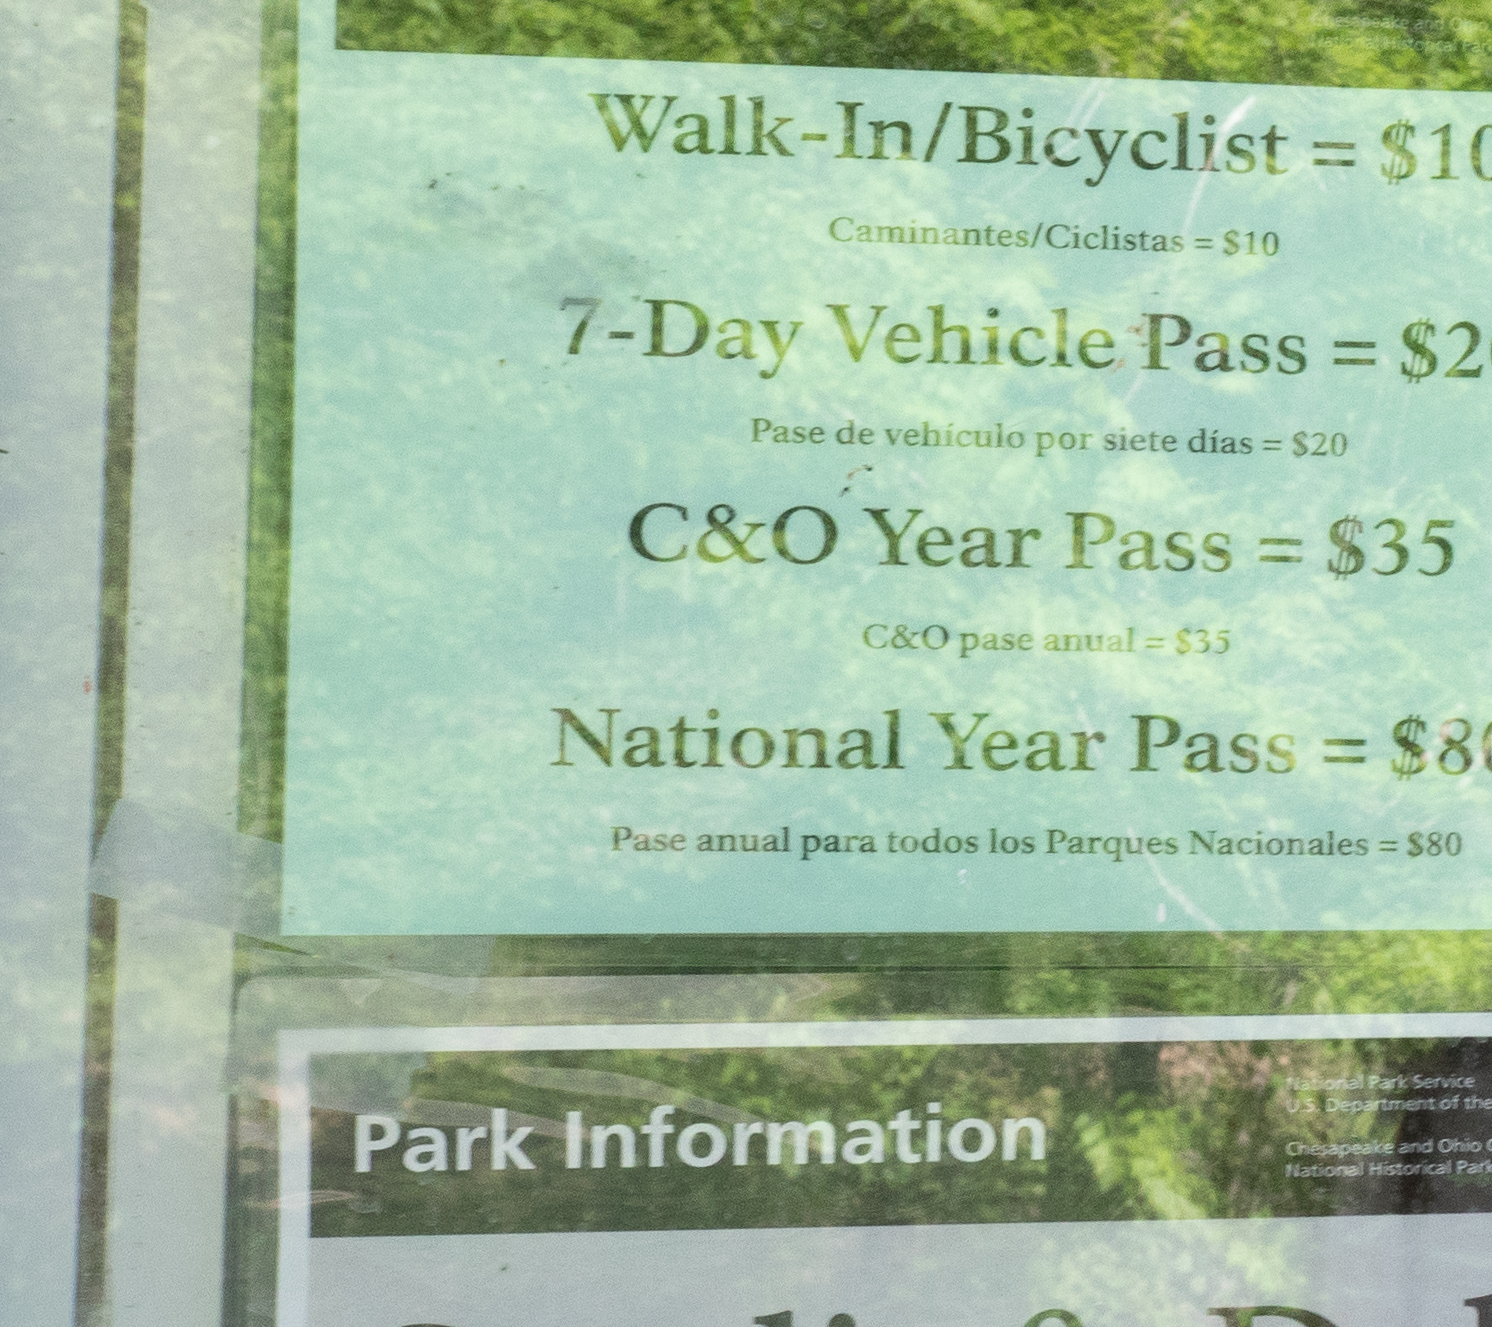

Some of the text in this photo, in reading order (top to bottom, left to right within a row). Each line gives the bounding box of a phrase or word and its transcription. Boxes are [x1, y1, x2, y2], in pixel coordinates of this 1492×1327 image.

[591, 94, 1289, 187] Walk-In/Bicyclist
[1312, 138, 1357, 168] =
[829, 216, 1185, 254] Caminantes/Ciclistas
[1223, 228, 1280, 259] $10
[558, 296, 803, 380] 7-Day
[827, 303, 1117, 371] Vehicle
[1140, 313, 1308, 377] Pass
[1332, 339, 1377, 367] =
[750, 417, 826, 447] Pase
[835, 418, 876, 447] de
[884, 418, 1026, 451] vehículo
[1035, 429, 1093, 458] por
[1102, 425, 1179, 454] siete
[1188, 426, 1254, 456] días
[1292, 430, 1348, 461] $20
[627, 501, 1456, 581] C&O Year Pass = $35
[862, 622, 949, 653] C&O
[959, 630, 1033, 660] pase
[1041, 624, 1136, 655] anual
[1175, 624, 1230, 658] $35
[549, 707, 903, 772] National
[928, 711, 1107, 775] Year
[1130, 714, 1298, 777] Pass
[1322, 736, 1368, 767] =
[611, 825, 687, 855] Pase
[697, 825, 790, 855] anual
[801, 833, 878, 863] para
[886, 825, 979, 856] todos
[988, 826, 1036, 857] los
[1046, 828, 1179, 864] Parques
[1188, 828, 1369, 860] Nacionales
[1407, 828, 1463, 861] $80
[1369, 1075, 1409, 1091] Park
[1413, 1074, 1476, 1089] Service
[1285, 1096, 1317, 1113] U.S.
[1326, 1095, 1437, 1115] Department
[1441, 1094, 1461, 1110] of
[1464, 1095, 1492, 1110] the
[354, 1101, 1048, 1176] Park Information
[1285, 1139, 1394, 1160] Chesapeake
[1398, 1138, 1433, 1155] and
[1437, 1137, 1482, 1154] Ohio
[1285, 1161, 1364, 1178] National
[1369, 1160, 1452, 1177] Historical
